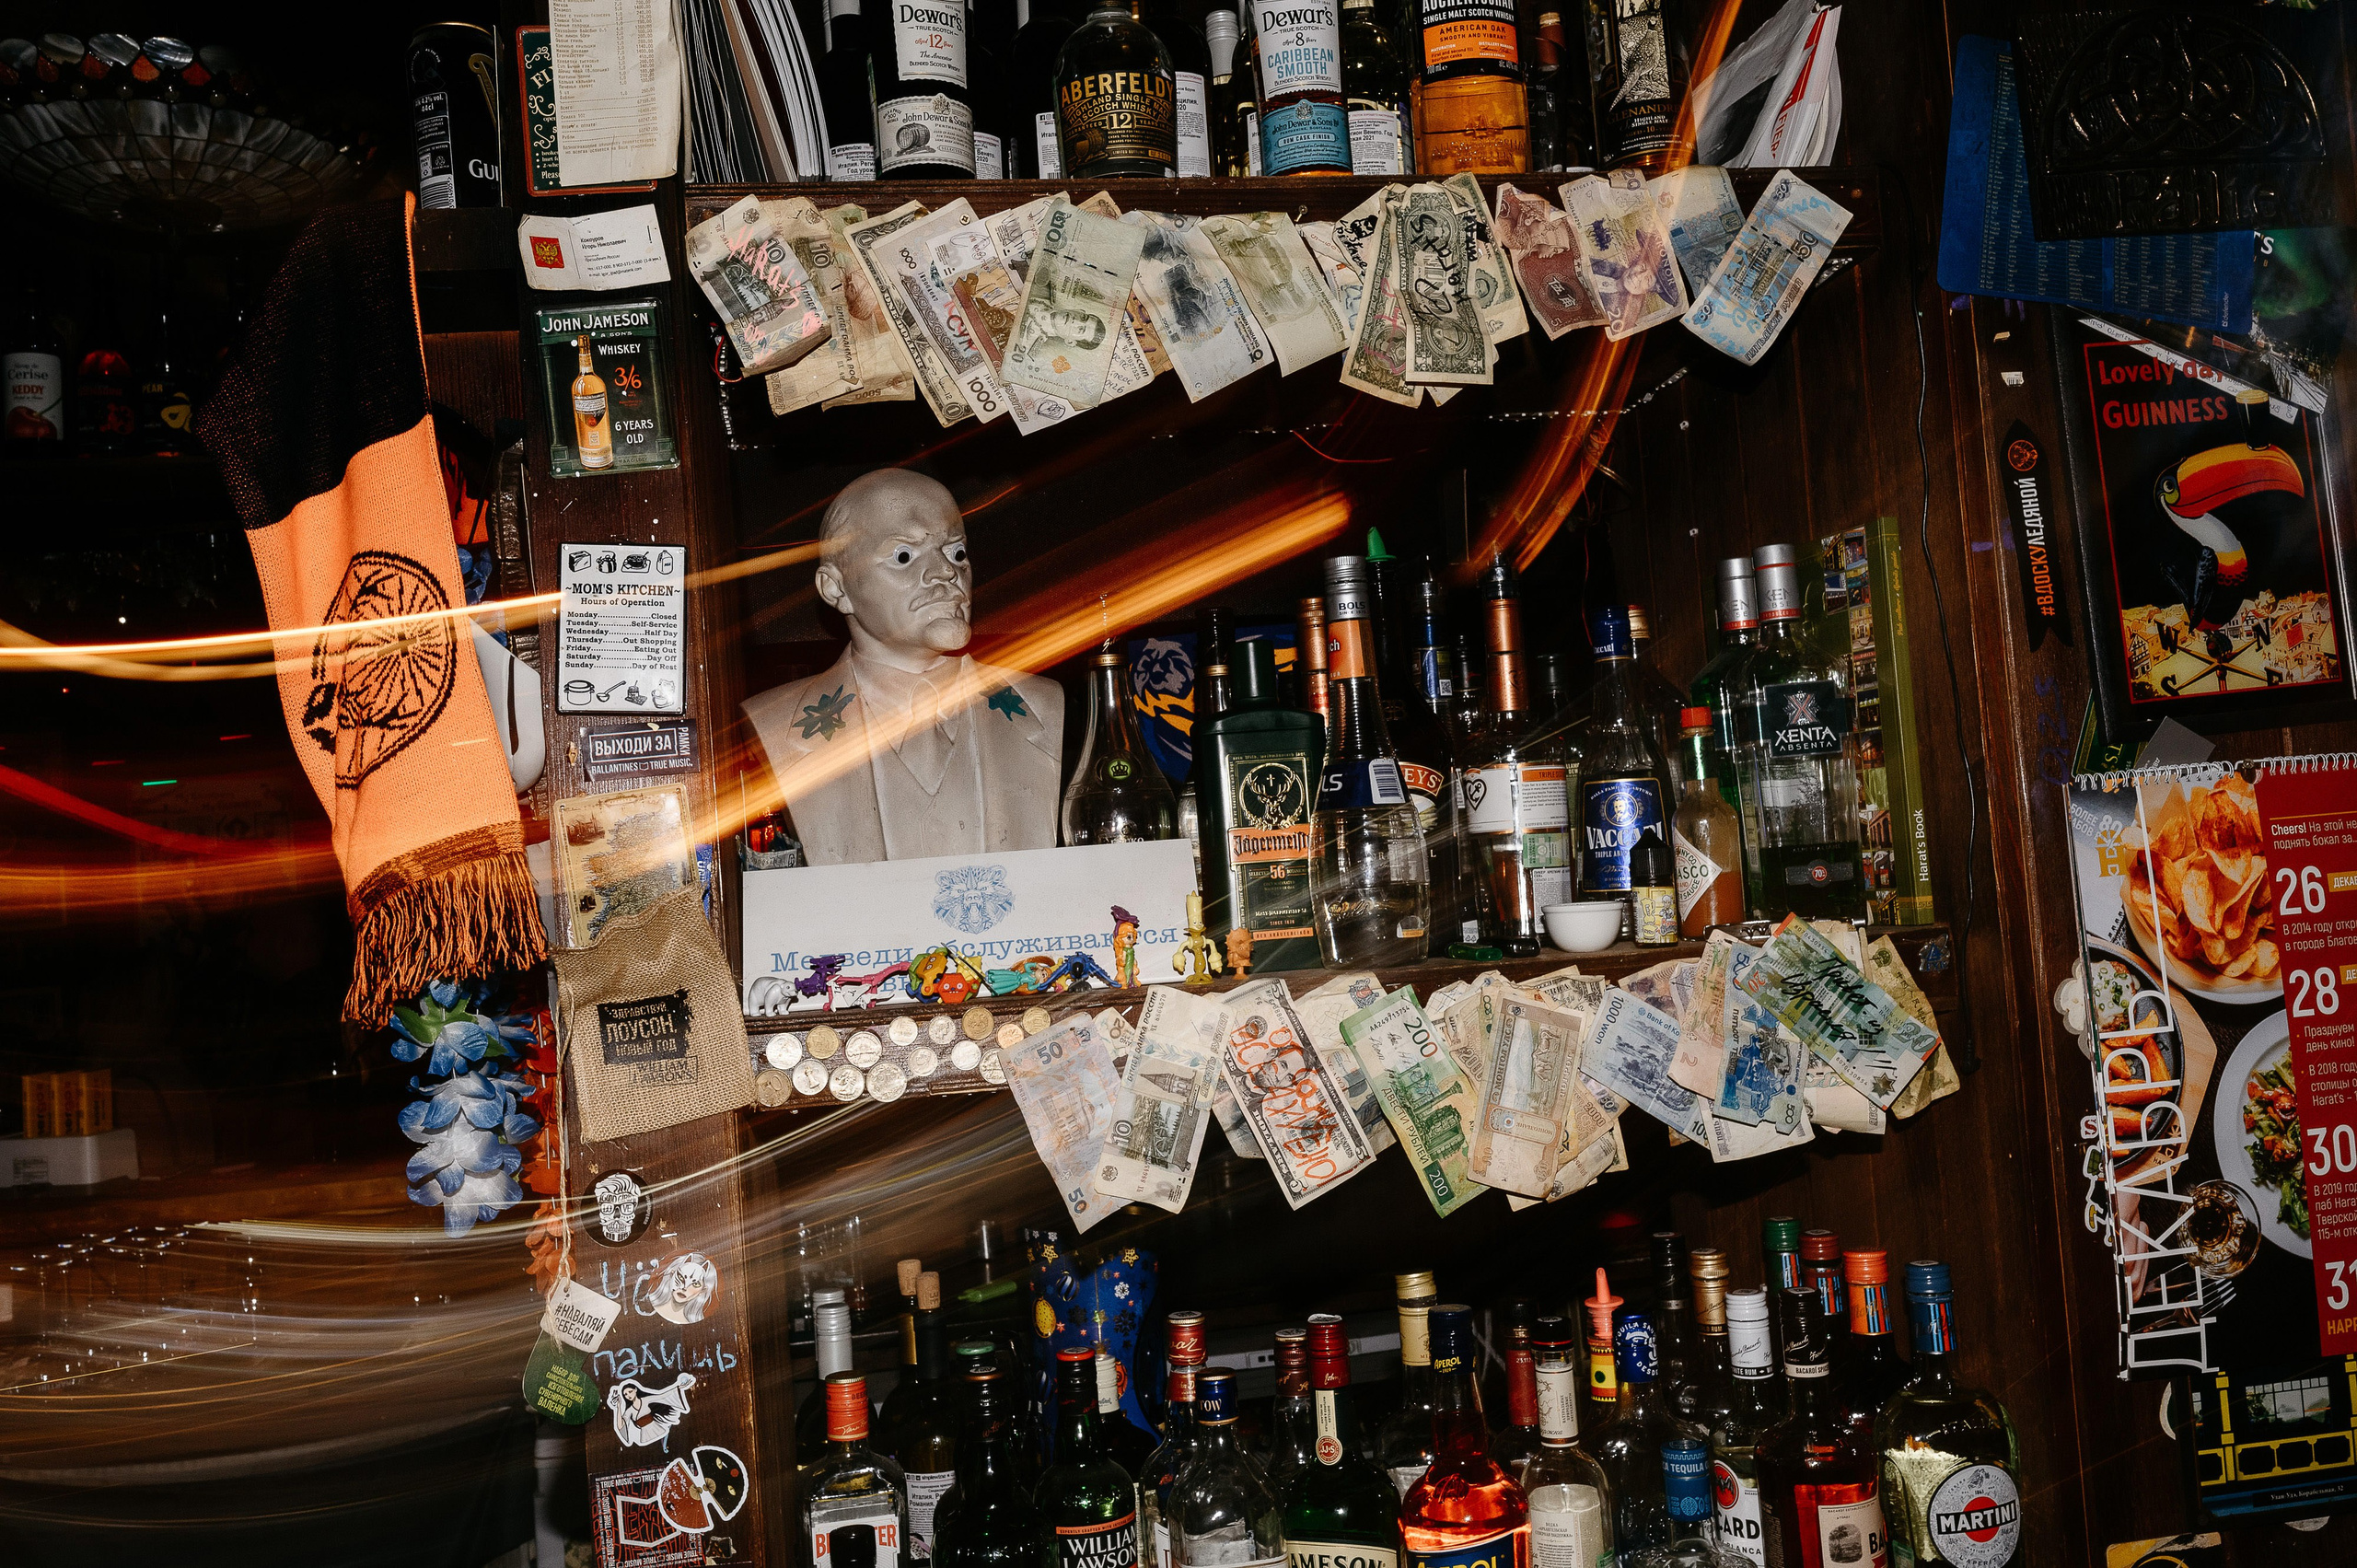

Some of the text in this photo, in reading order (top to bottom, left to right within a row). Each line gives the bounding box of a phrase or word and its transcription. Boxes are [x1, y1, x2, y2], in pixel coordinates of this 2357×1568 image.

[1423, 8, 1515, 25] SINGLE MALT SCOTCH WHISKY
[932, 27, 954, 35] SCOTCH
[1295, 32, 1305, 46] 8
[1439, 24, 1489, 35] AMERICAN
[1439, 33, 1466, 42] SMOOTH
[929, 33, 944, 49] 12
[1268, 48, 1334, 68] CARIBBEAN
[1277, 61, 1328, 79] SMOOTH
[1062, 72, 1174, 108] ABERFELDY
[923, 111, 948, 122] Dewar
[1069, 93, 1170, 124] HIGHLAND SINGLE MALT
[1083, 101, 1158, 122] SCOTCH WHISKY
[1633, 114, 1666, 123] HIGHLAND
[1109, 112, 1132, 129] 12
[1287, 120, 1311, 128] Dewar
[1646, 125, 1655, 134] 10
[1621, 168, 1642, 192] 20
[597, 238, 627, 248] Николаевич
[763, 237, 786, 264] 10
[1215, 237, 1234, 257] YUAN
[1791, 231, 1818, 261] 50
[809, 242, 831, 268] 10
[900, 248, 917, 270] 1000
[1547, 274, 1577, 308] 伍角
[542, 312, 649, 333] JOHN JAMESON
[1607, 308, 1624, 333] 20
[1745, 277, 1805, 363] ПЯТЬДЕСЯТ РУБЛЕЙ
[598, 343, 641, 355] WHISKEY
[1011, 343, 1027, 364] 20
[1248, 349, 1264, 364] 10
[1132, 343, 1149, 377] РОССИИ
[2098, 356, 2176, 386] Lovely
[12, 385, 44, 395] KEDDY
[141, 383, 164, 394] PEAR
[967, 377, 997, 413] 1000
[2102, 397, 2228, 429] GUINNESS
[615, 419, 654, 432] 6 YEARS
[626, 433, 644, 444] OLD
[2013, 477, 2056, 617] #ВДОСКУЛЕДЯНОЙ
[581, 598, 665, 608] Hours of Operation
[1338, 601, 1366, 612] BOLS
[640, 637, 678, 646] Shopping
[663, 630, 678, 638] Day
[659, 663, 678, 671] Rest
[595, 726, 691, 756] ВЫХОДИ ЗА РАМКИ
[1775, 726, 1837, 746] XENTA
[1779, 740, 1833, 751] ABSENTA
[591, 760, 668, 774] BALLANTINES TRUE
[2071, 803, 2099, 827] БОЛЕЕ
[2270, 820, 2344, 837] Cheers! На этой
[1914, 808, 1930, 882] Harat's Book
[2273, 833, 2340, 850] поднять бокал
[1595, 851, 1612, 859] TRIPLE
[1270, 865, 1285, 879] 56
[1683, 878, 1701, 900] SAUCE
[2275, 865, 2326, 916] 26
[2282, 922, 2337, 935] В 2014 году
[2293, 940, 2326, 952] городе
[1747, 970, 1767, 993] 20
[2289, 966, 2340, 1018] 28
[1109, 1017, 1127, 1040] 20
[1593, 994, 1626, 1046] 1000 won
[1645, 1012, 1681, 1038] Bank of Ko
[1732, 1008, 1740, 1046] ПЯТЬСОТ
[1126, 991, 1157, 1084] БИЛЕТ РОССИИ
[1403, 1016, 1438, 1058] 200
[1892, 1022, 1937, 1054] 20
[2305, 1024, 2355, 1038] Празднуем
[656, 1040, 677, 1054] ГОД
[1036, 1042, 1063, 1064] 50
[1199, 1012, 1229, 1098] ДЕСЯТЬ РУБЛЕЙ
[2306, 1037, 2355, 1053] день кино!
[2309, 1064, 2337, 1075] В 2018
[2311, 1079, 2350, 1093] столицы
[2313, 1092, 2345, 1107] Harat's
[1584, 1100, 1607, 1128] 2000
[1784, 1103, 1795, 1126] 500
[1112, 1120, 1133, 1146] 10
[1381, 1087, 1430, 1166] ДВЕСТИ РУБЛЕЙ
[1253, 1109, 1291, 1176] DOLLARS
[2307, 1124, 2356, 1176] 30
[1428, 1169, 1449, 1197] 200
[2098, 989, 2219, 1374] ДЕКАБРЬ
[2314, 1184, 2341, 1196] В 2019
[1067, 1191, 1088, 1214] 50
[2316, 1200, 2332, 1211] паб
[2318, 1227, 2340, 1240] 115-м
[554, 1302, 606, 1333] #НАВАЛЯЙ
[1713, 1324, 1724, 1332] RUM
[552, 1365, 567, 1376] НАБОР
[1434, 1355, 1462, 1370] APEROL
[1744, 1366, 1758, 1376] RUM
[538, 1387, 573, 1408] СУВЕНИРНОГО
[548, 1382, 585, 1404] ИЗГОТОВЛЕНИЯ
[538, 1397, 566, 1416] ВАЛЕНКА
[1670, 1462, 1704, 1474] TEQUILA
[600, 1481, 615, 1489] TRUE
[615, 1478, 633, 1487] MUSIC
[1940, 1502, 2015, 1534] MARTINI
[666, 1551, 683, 1562] MUSIC
